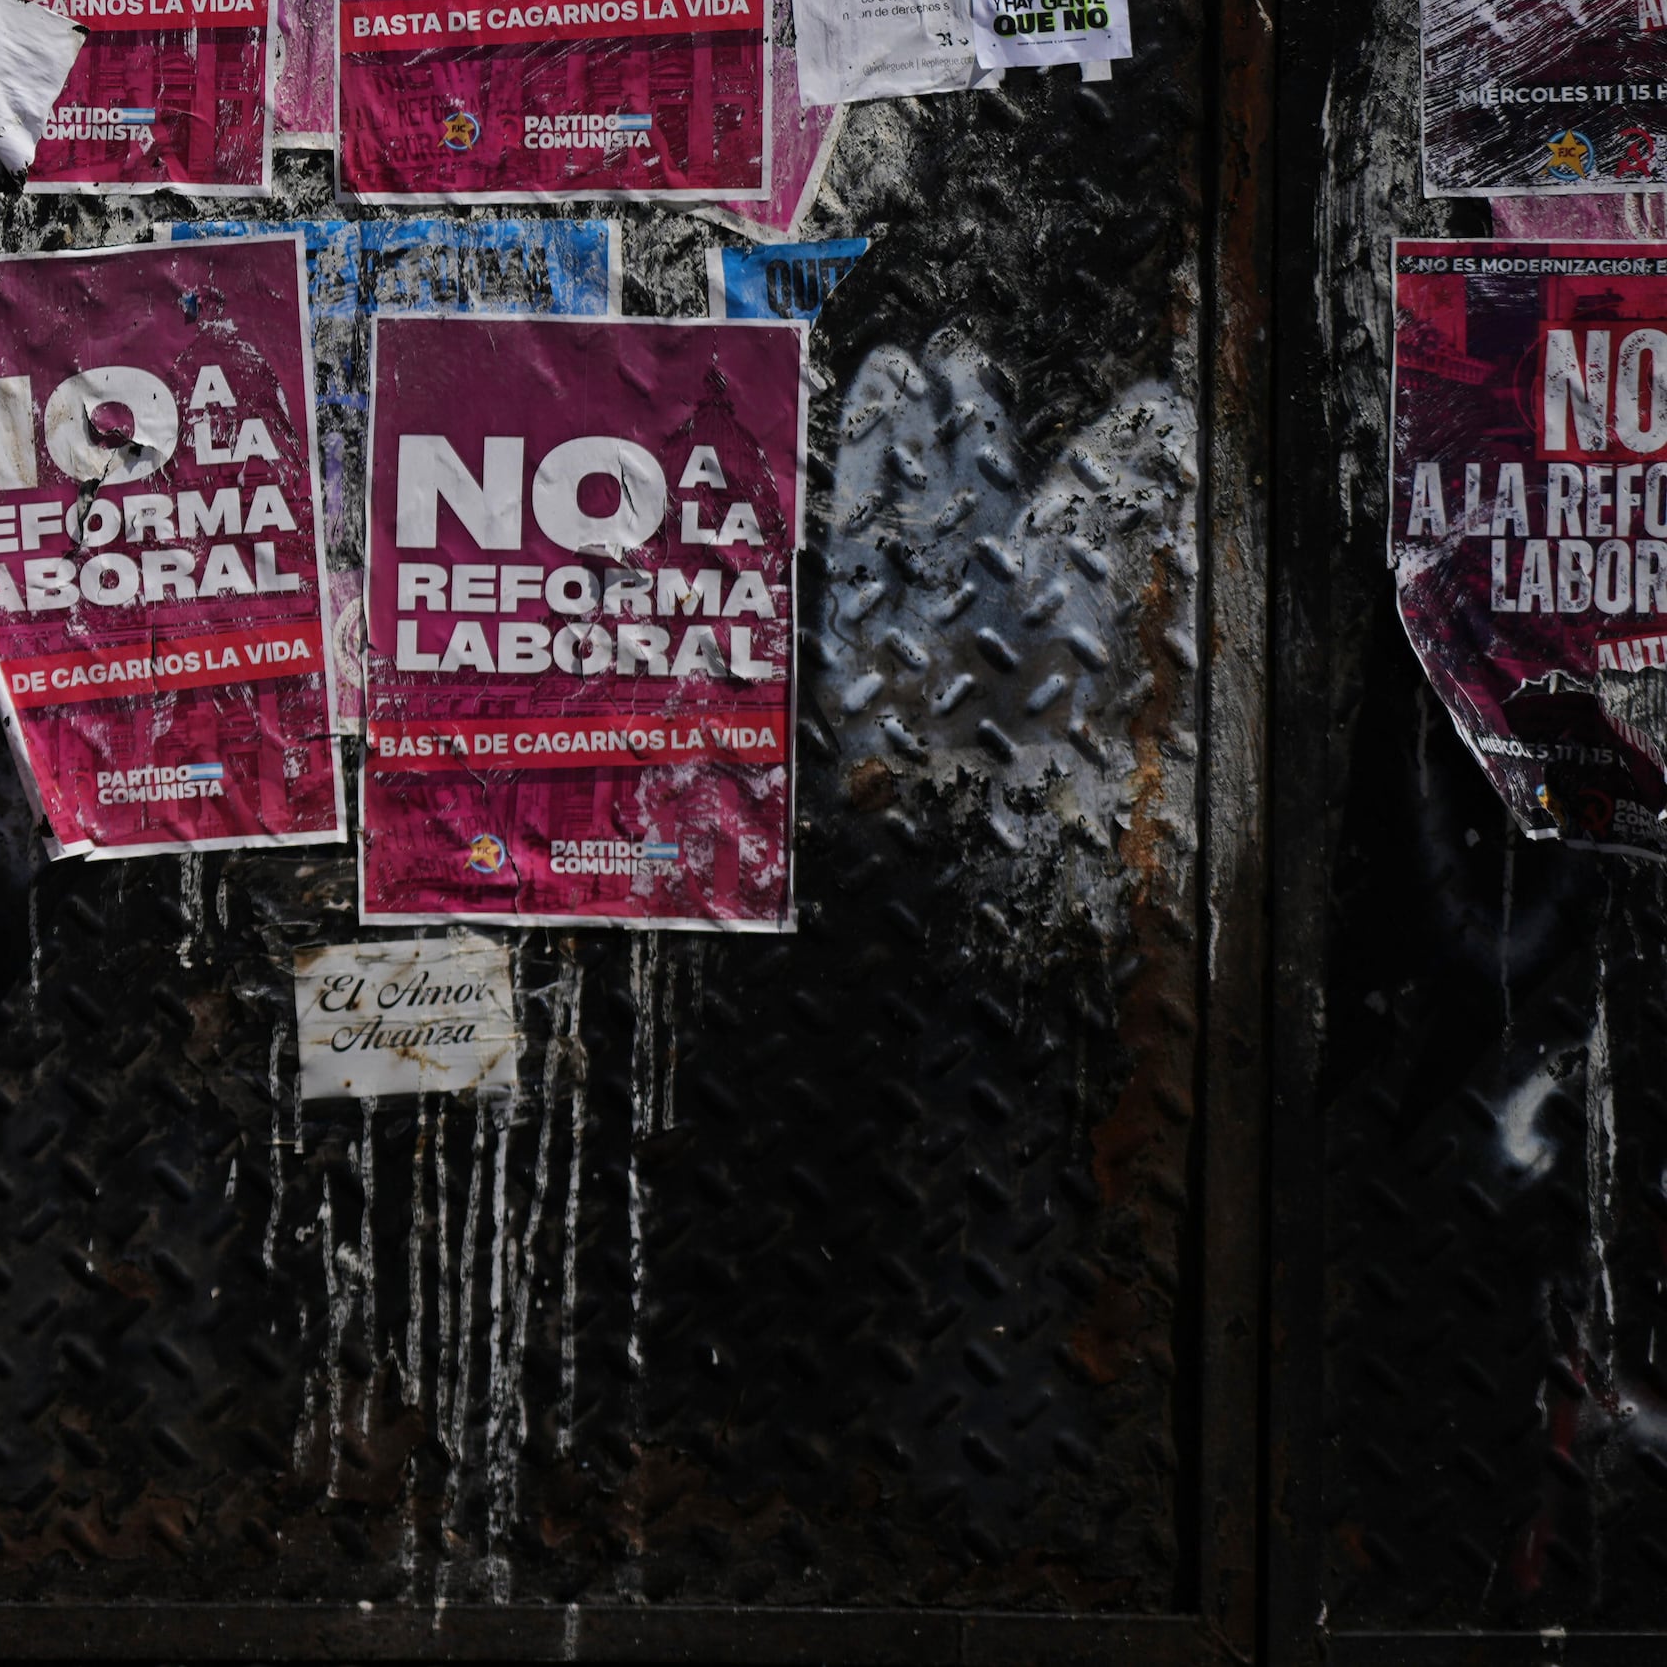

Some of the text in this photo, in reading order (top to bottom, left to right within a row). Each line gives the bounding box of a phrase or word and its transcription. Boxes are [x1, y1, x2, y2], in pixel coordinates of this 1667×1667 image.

[352, 9, 444, 36] BASTA
[450, 8, 483, 30] DE
[487, 0, 639, 30] CAGARNOS
[875, 2, 940, 17] de derechos
[993, 8, 1108, 36] QUE NO
[525, 115, 617, 132] PARTIDO
[525, 131, 651, 149] COMUNISTA
[1418, 257, 1475, 273] NO ES
[190, 365, 237, 410] A
[194, 418, 280, 466] LA
[397, 435, 728, 551] NO A
[1407, 462, 1528, 537] A LA
[682, 502, 765, 546] LA
[398, 564, 775, 621] REFORMA
[11, 640, 309, 694] DE CAGARNOS LA VIDA
[397, 622, 772, 680] LABORAL
[379, 727, 776, 759] BASTA DE CAGARNOS LA VIDA
[97, 766, 190, 788] PARTIDO
[98, 780, 223, 804] COMUNISTA
[550, 857, 680, 875] COMUNISTA
[551, 841, 644, 857] PARTIDO
[319, 972, 358, 1016] El
